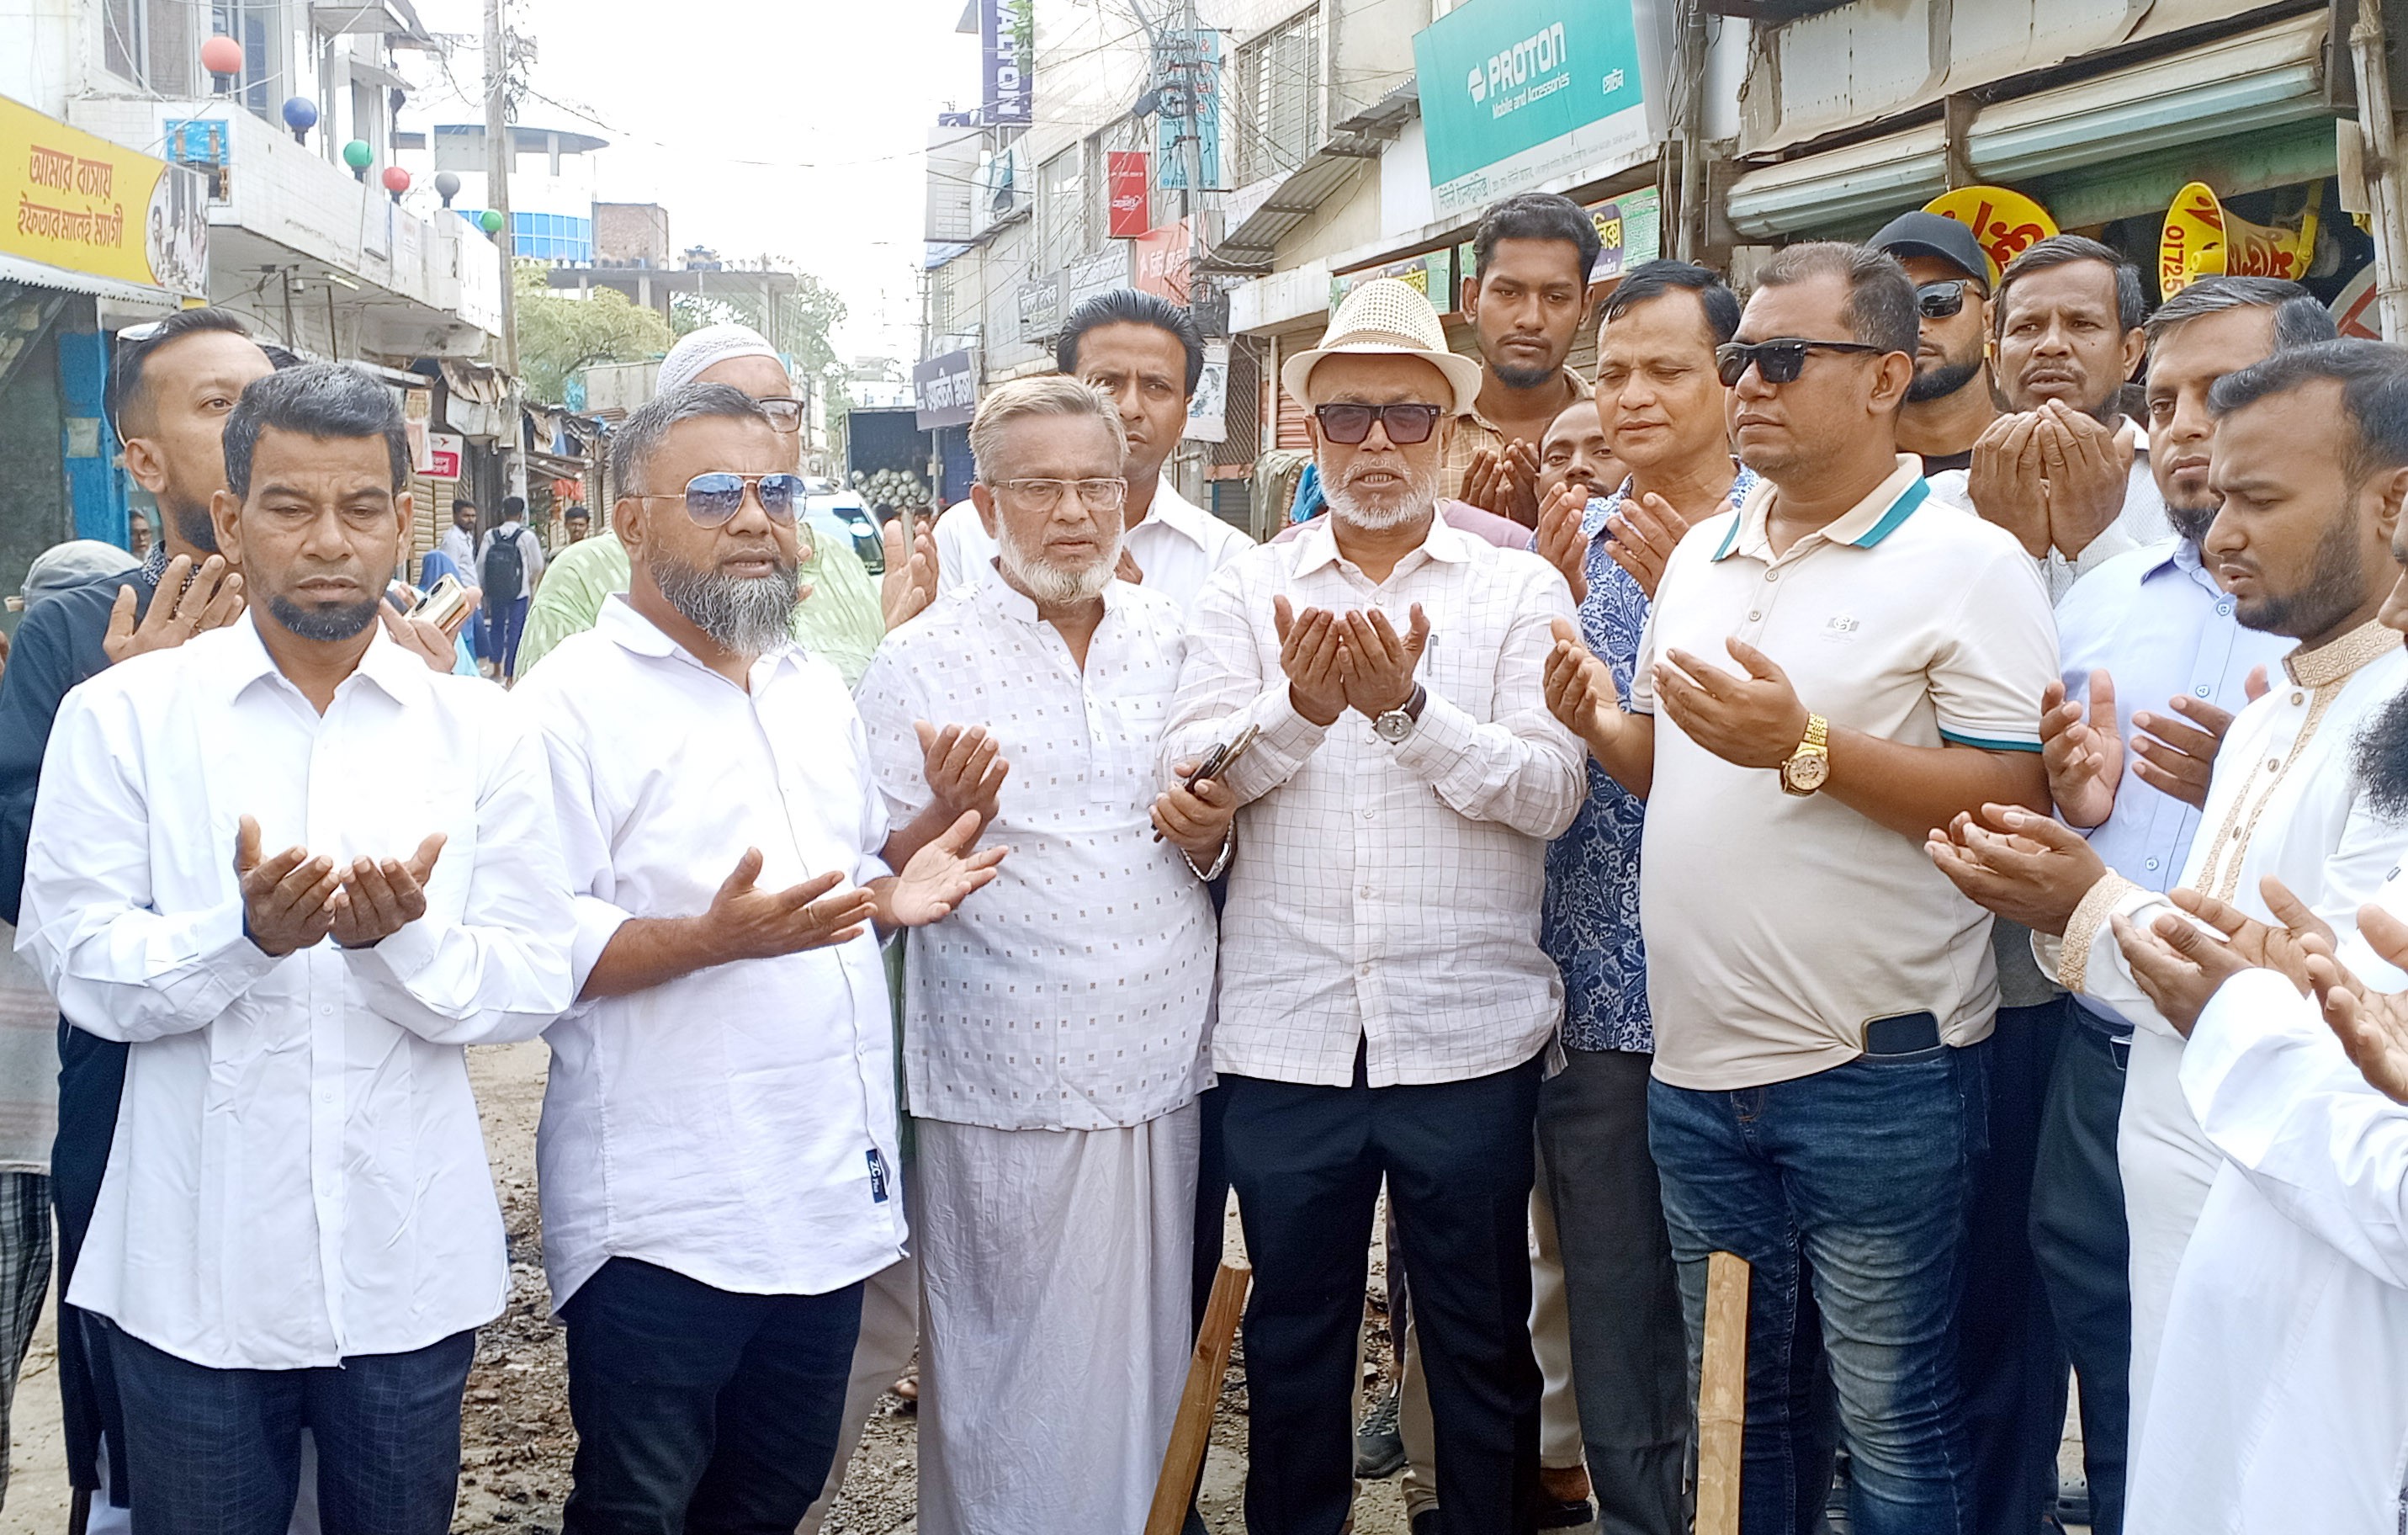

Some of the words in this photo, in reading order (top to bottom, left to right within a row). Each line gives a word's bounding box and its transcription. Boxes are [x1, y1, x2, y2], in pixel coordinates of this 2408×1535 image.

[996, 0, 1021, 114] ALTON
[1492, 93, 1513, 120] Mobile
[1514, 88, 1527, 110] and
[1528, 71, 1571, 104] Accessories
[29, 144, 74, 195] আমার
[77, 157, 113, 204] বাসায়
[18, 190, 61, 242] ইফতার
[61, 204, 93, 246] মানেই
[94, 203, 123, 248] ম্যাগী
